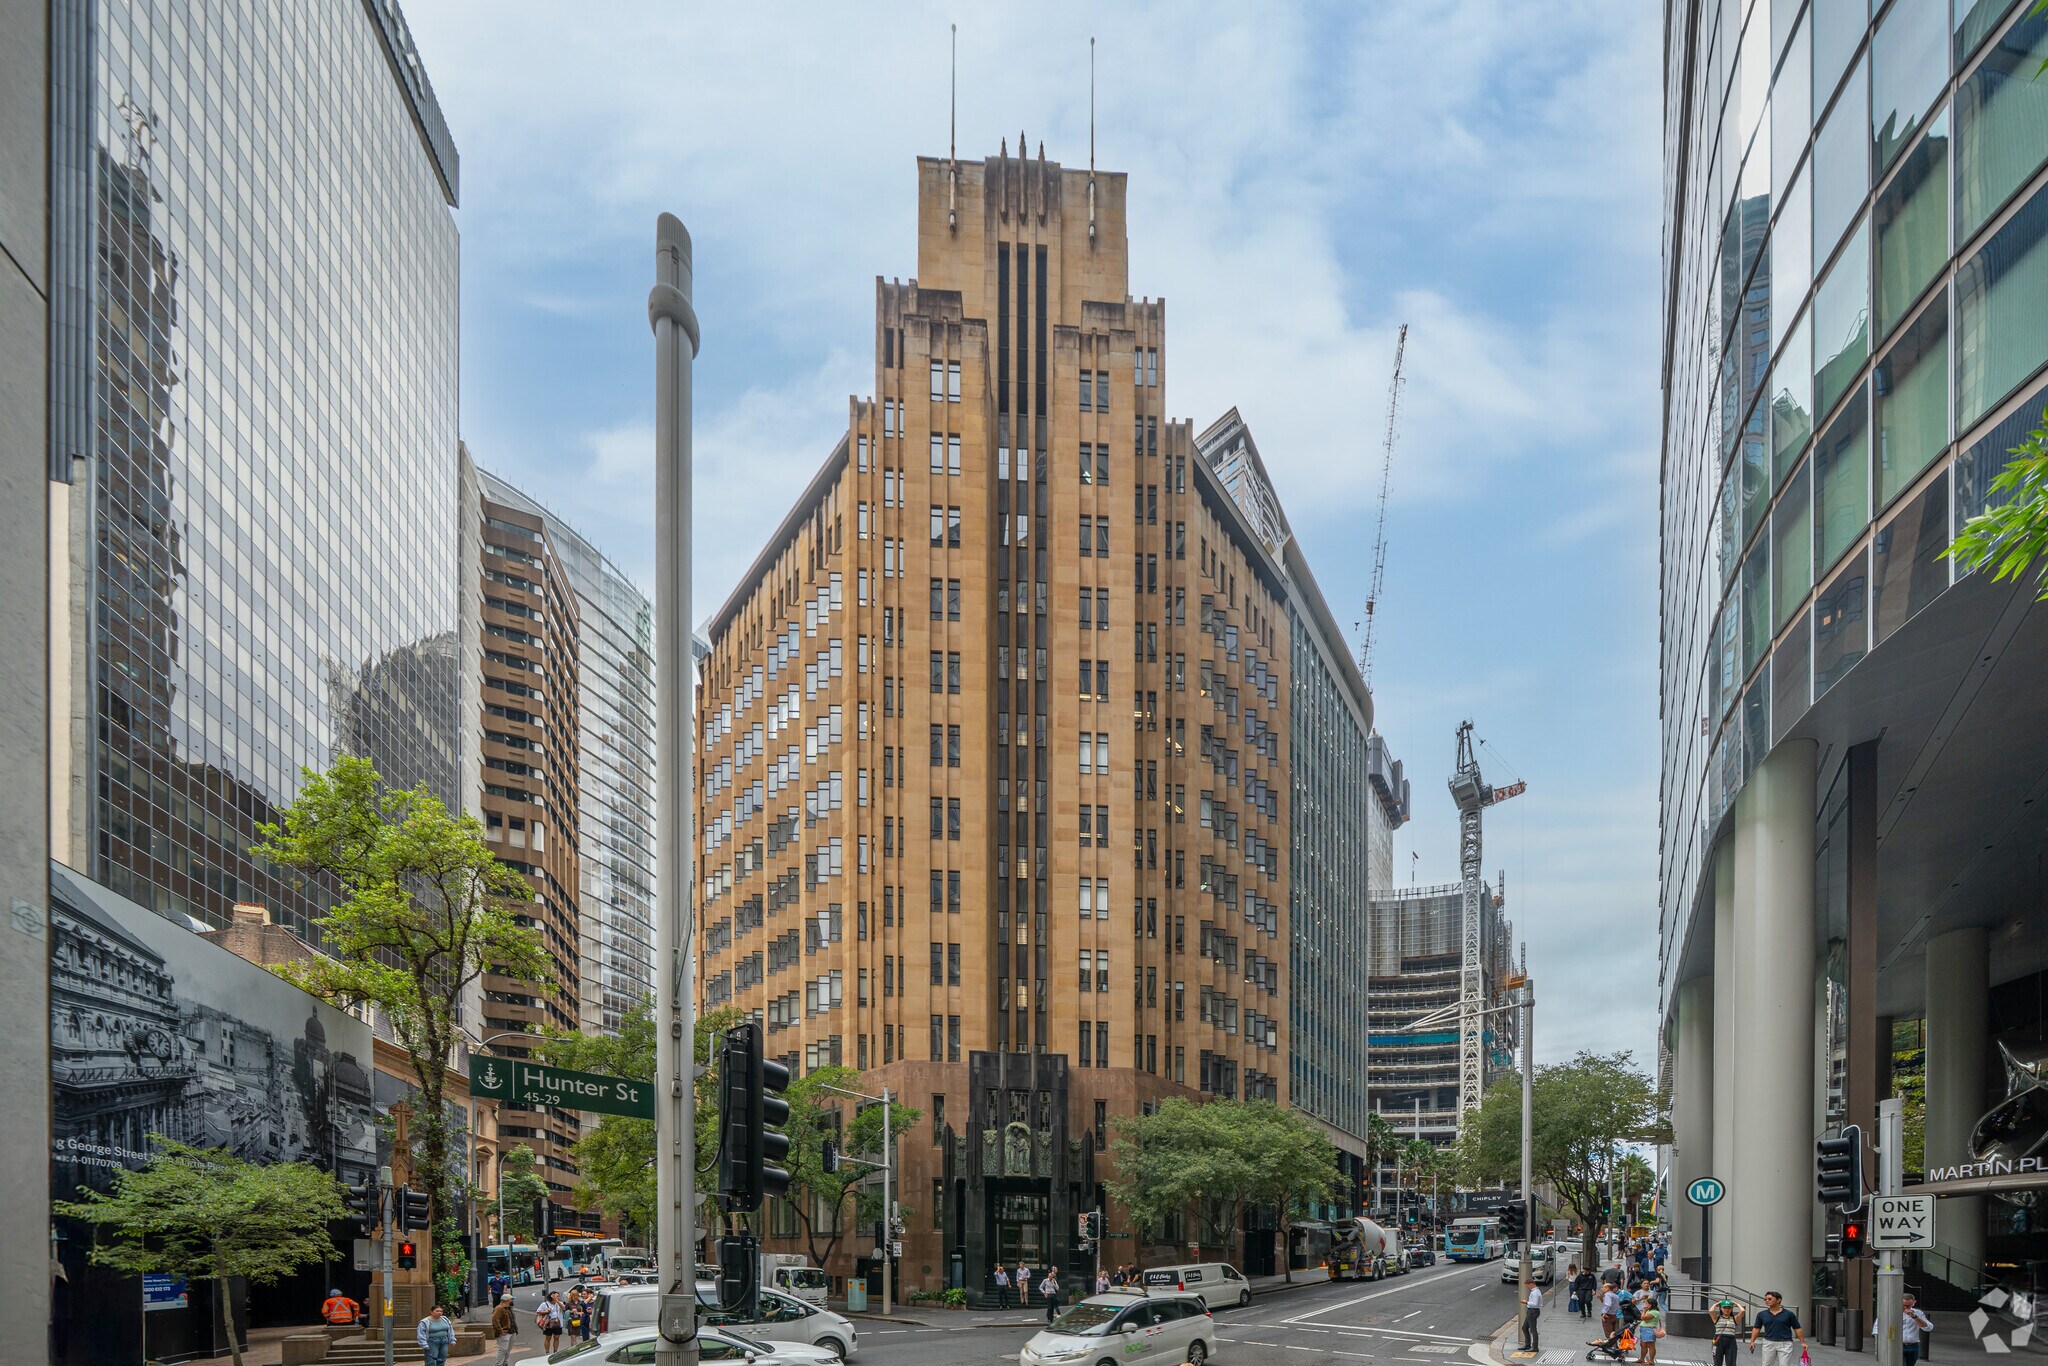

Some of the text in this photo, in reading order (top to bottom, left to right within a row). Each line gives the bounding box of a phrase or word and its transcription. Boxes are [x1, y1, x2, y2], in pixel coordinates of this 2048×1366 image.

[523, 1067, 639, 1103] Hunter St
[523, 1091, 561, 1105] 45-29
[67, 1138, 112, 1156] George
[113, 1146, 148, 1161] Street
[71, 1154, 123, 1169] A-01170709
[1929, 1160, 2012, 1182] MARTIN
[1696, 1184, 1715, 1200] M
[1882, 1200, 1924, 1213] ONE
[1879, 1216, 1927, 1229] WAY
